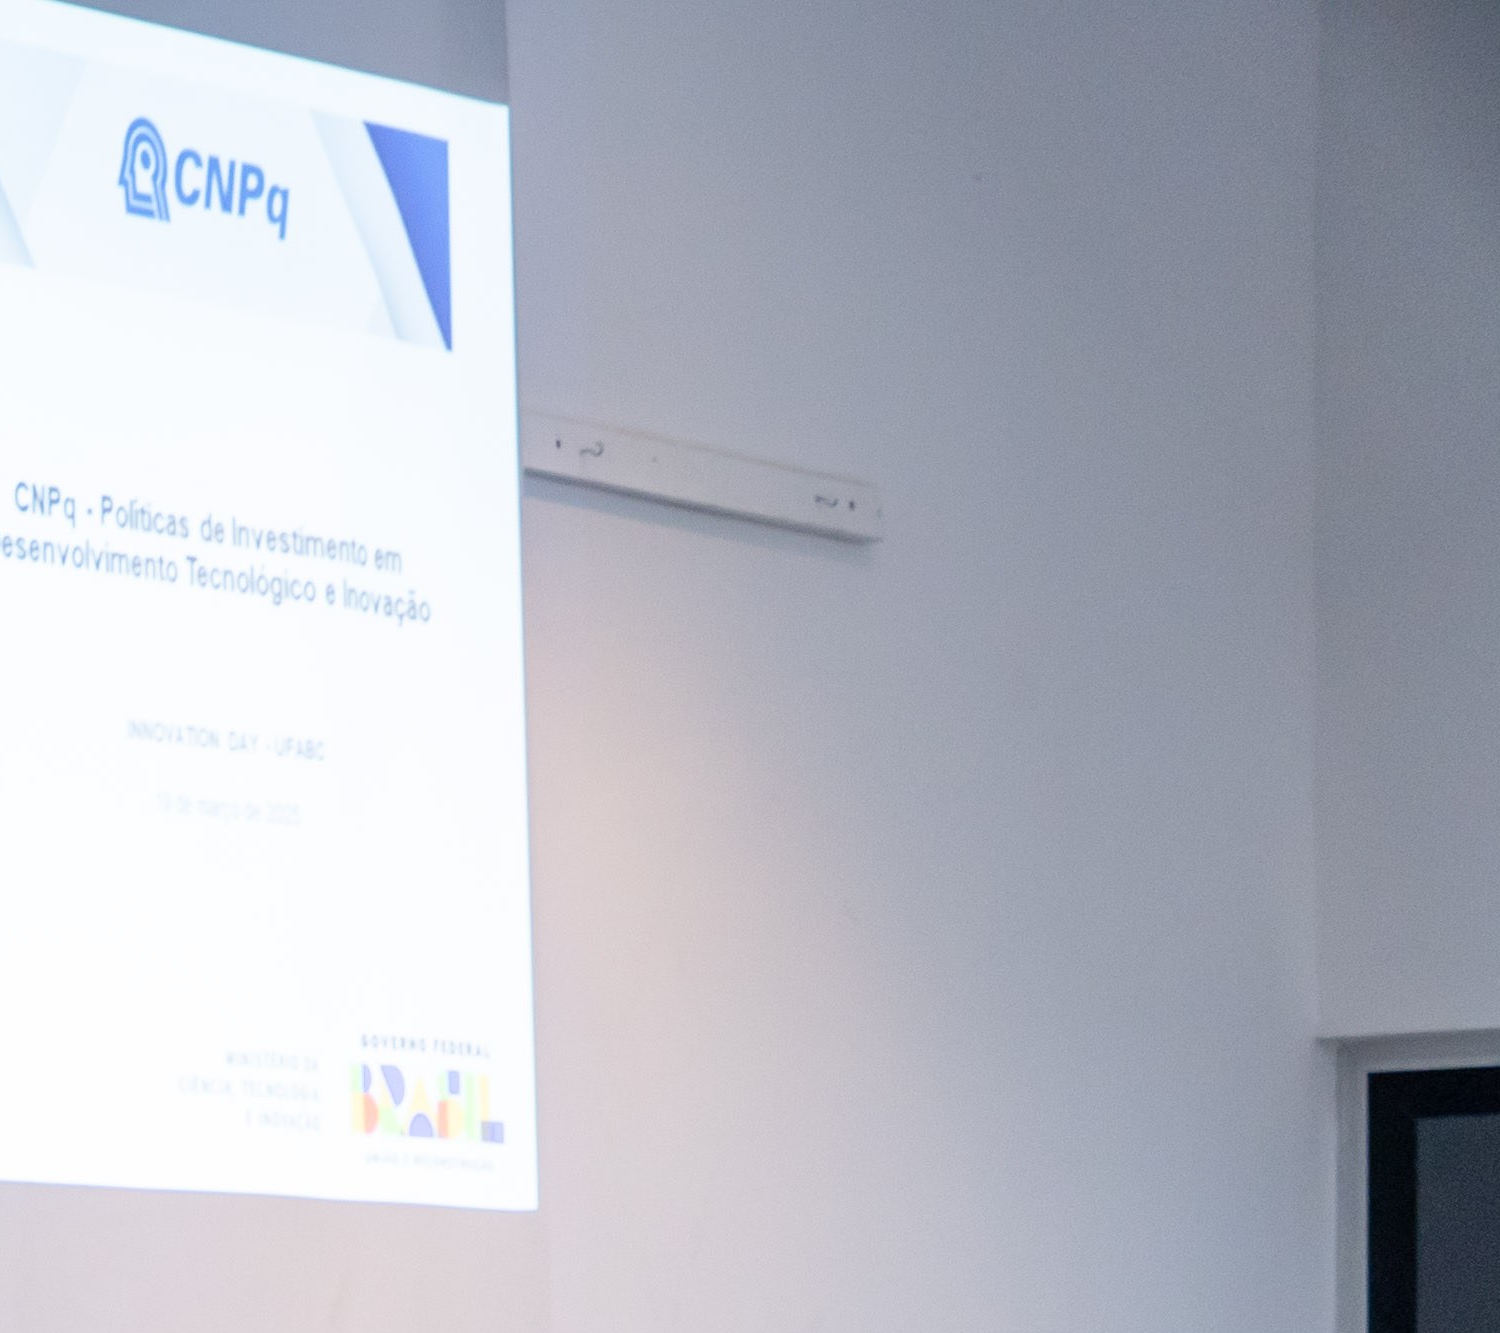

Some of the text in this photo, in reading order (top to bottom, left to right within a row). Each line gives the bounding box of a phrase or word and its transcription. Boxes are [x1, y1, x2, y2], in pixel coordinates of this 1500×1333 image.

[172, 145, 291, 242] CNPq
[12, 479, 77, 529] CNPq
[99, 493, 191, 540] Políticas
[198, 511, 226, 545] de
[231, 515, 369, 568] Investimento
[373, 547, 403, 574] em
[184, 554, 317, 608] Tecnológico
[324, 582, 337, 607] e
[342, 578, 432, 628] Inovação
[127, 718, 220, 750] INNOVATION
[228, 730, 259, 754] DAY
[361, 1033, 491, 1059] GOVERNO FEDERAL
[350, 1062, 505, 1145] BRASIL
